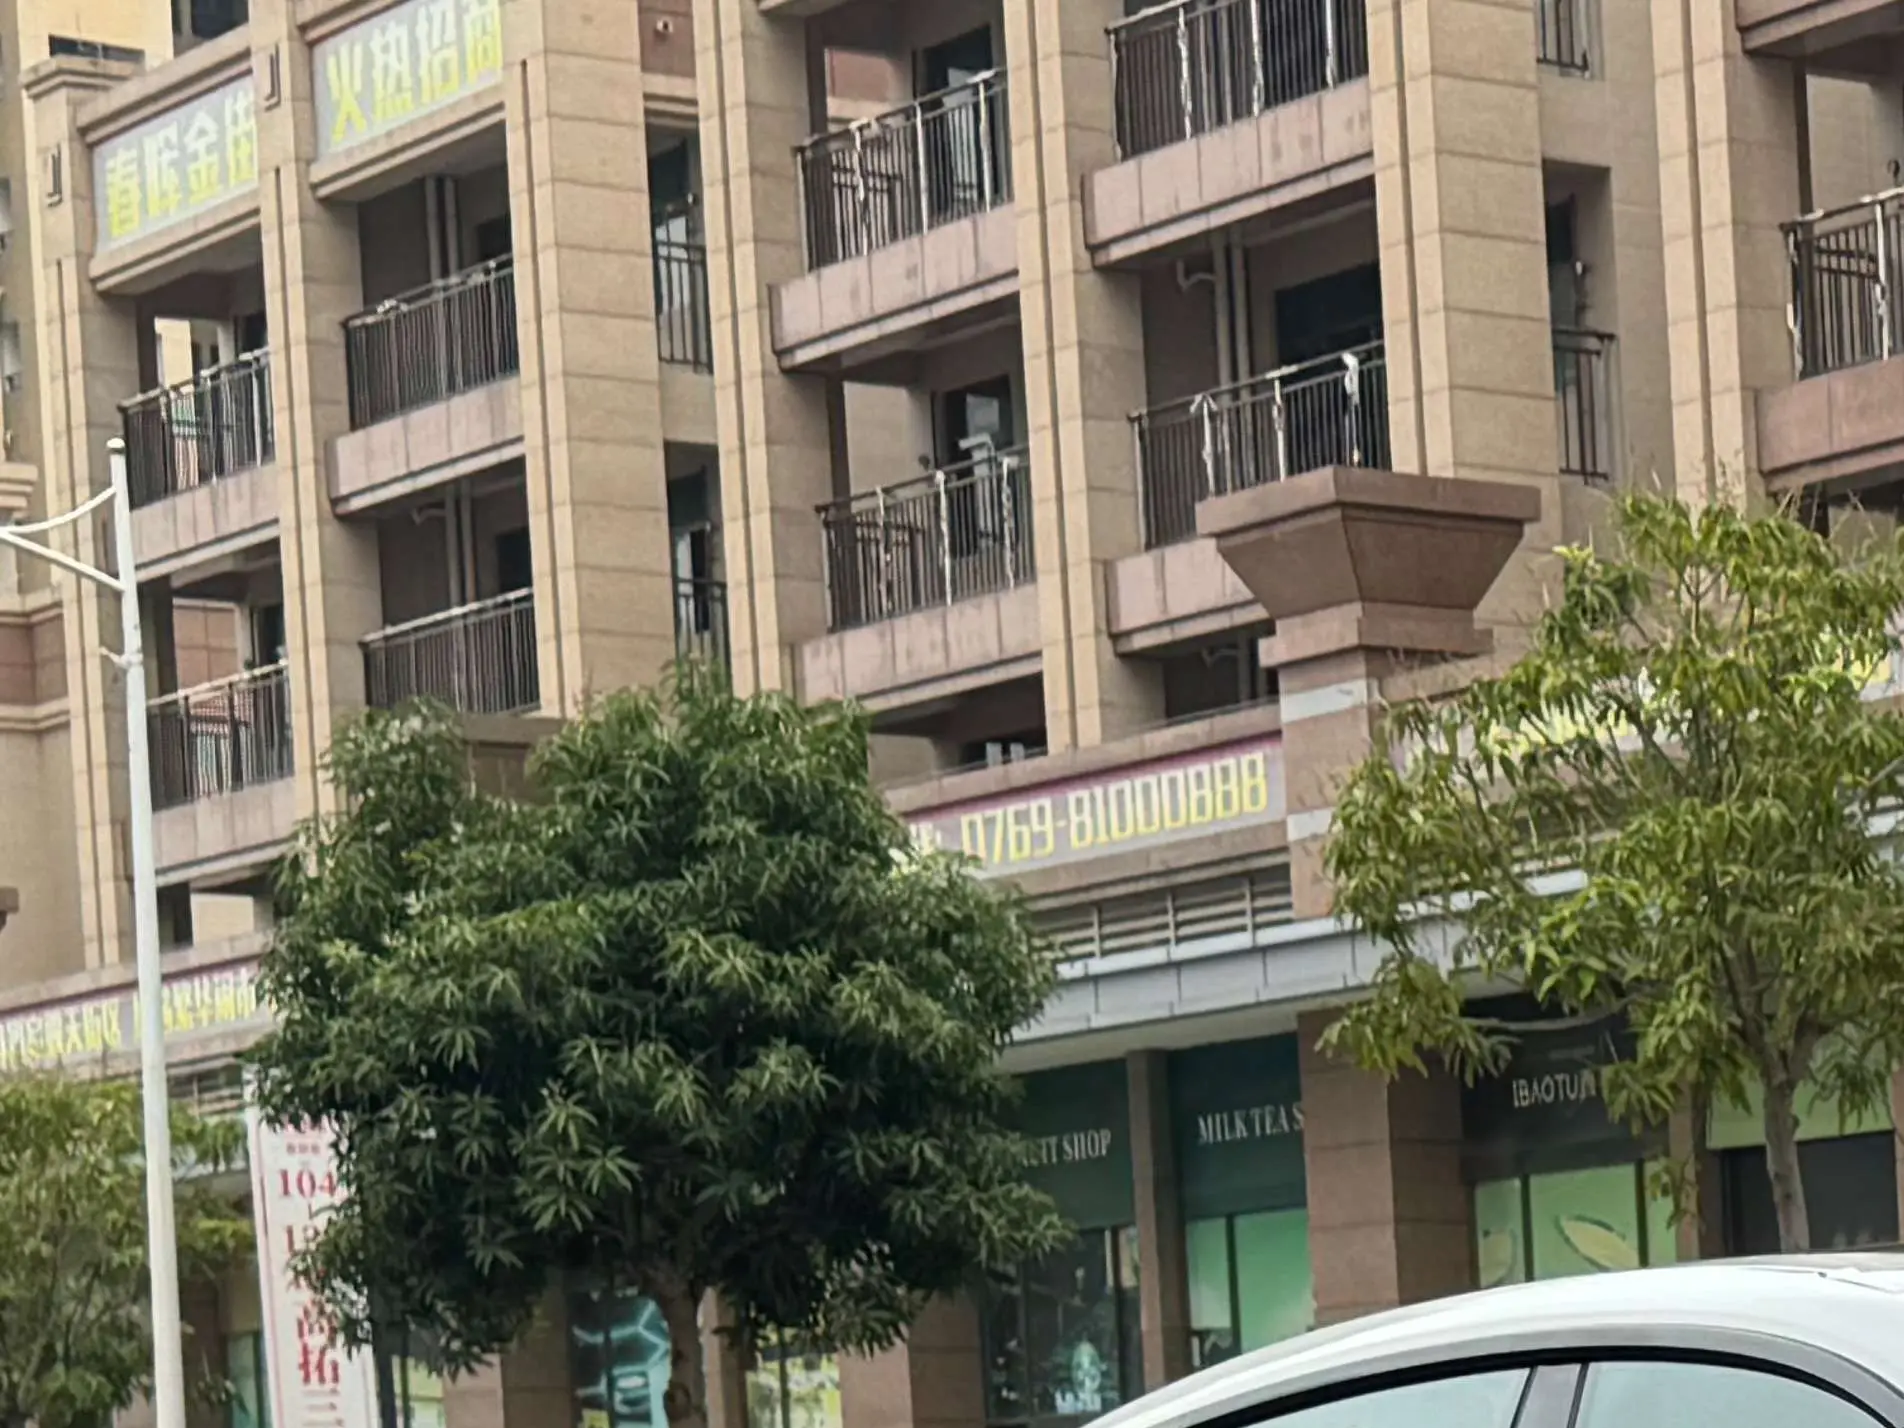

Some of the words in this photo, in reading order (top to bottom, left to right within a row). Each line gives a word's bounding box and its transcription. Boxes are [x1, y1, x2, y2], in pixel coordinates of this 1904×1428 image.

[960, 752, 1268, 864] 0769-81000888
[1062, 1128, 1112, 1162] SHOP
[1197, 1110, 1248, 1146] MILK
[1249, 1103, 1290, 1138] TEA
